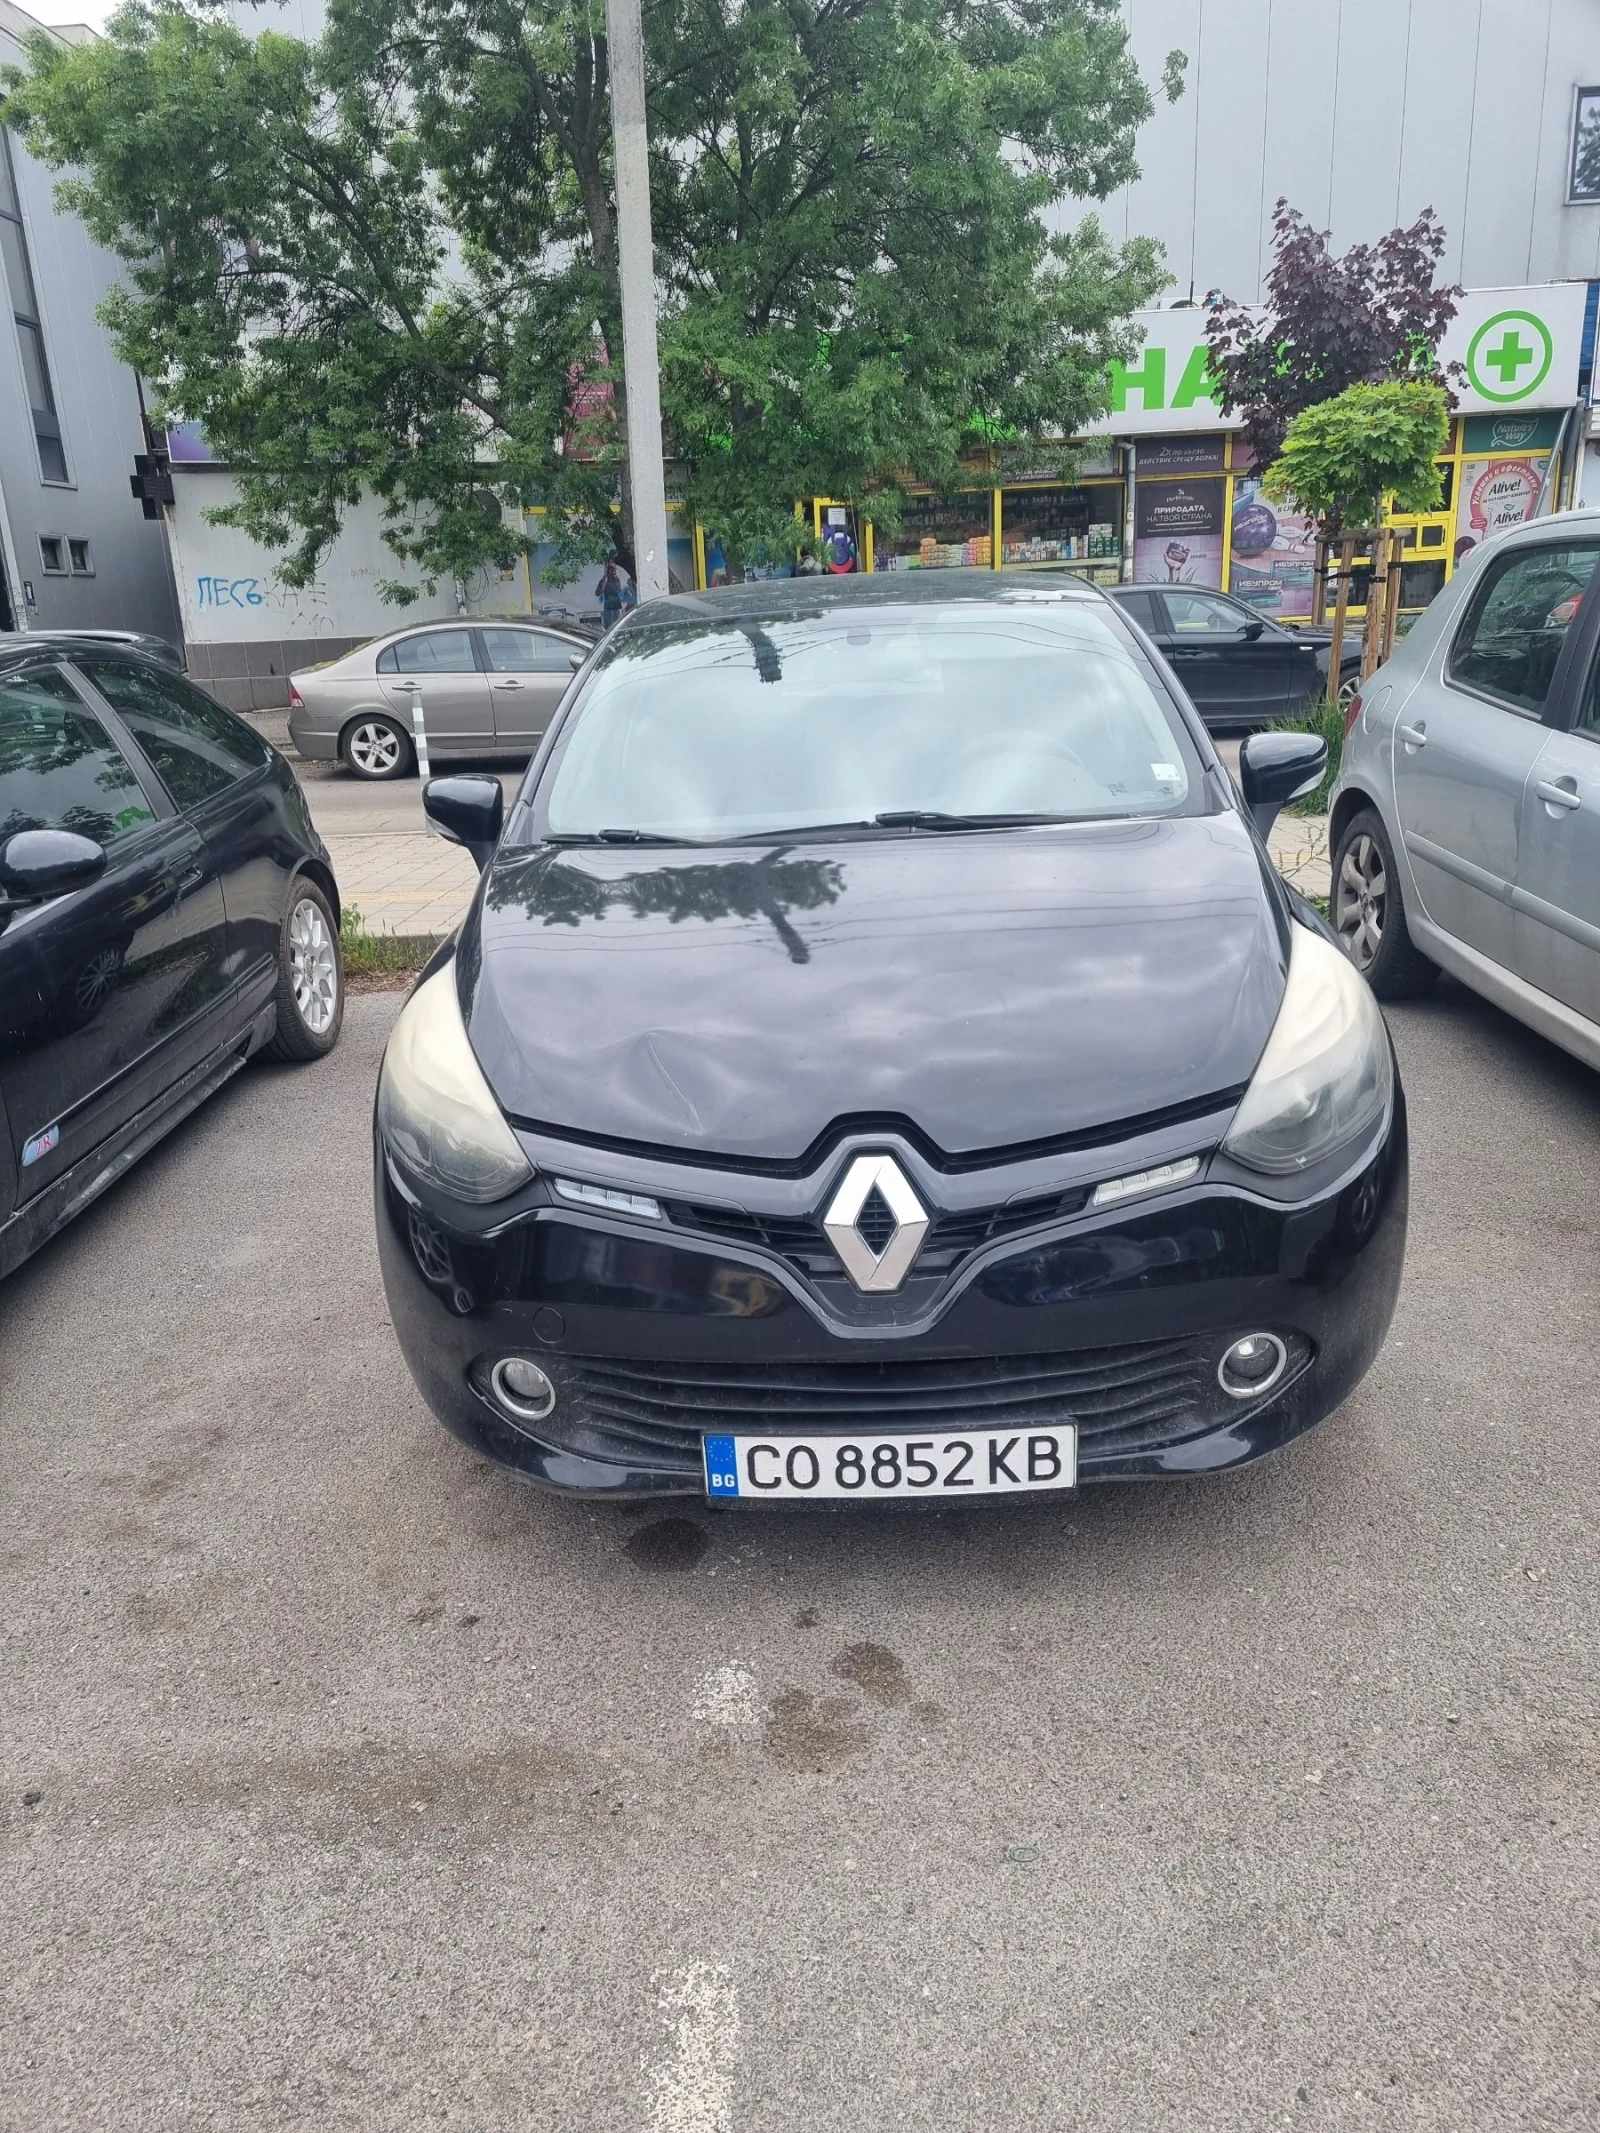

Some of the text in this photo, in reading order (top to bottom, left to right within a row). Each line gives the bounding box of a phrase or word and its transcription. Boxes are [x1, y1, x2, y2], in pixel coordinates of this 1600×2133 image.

[1505, 432, 1527, 441] Way
[1172, 455, 1195, 463] СРЕЩУ
[1195, 454, 1220, 462] БОЛКА!
[1488, 479, 1522, 496] Alive!
[1154, 505, 1205, 514] ПРИРОДАТА
[1146, 512, 1213, 523] НА ТВОЯ СТРАНА
[1493, 509, 1525, 526] Alive!
[746, 1434, 1063, 1490] CO 8852 KB
[711, 1473, 735, 1488] BG
